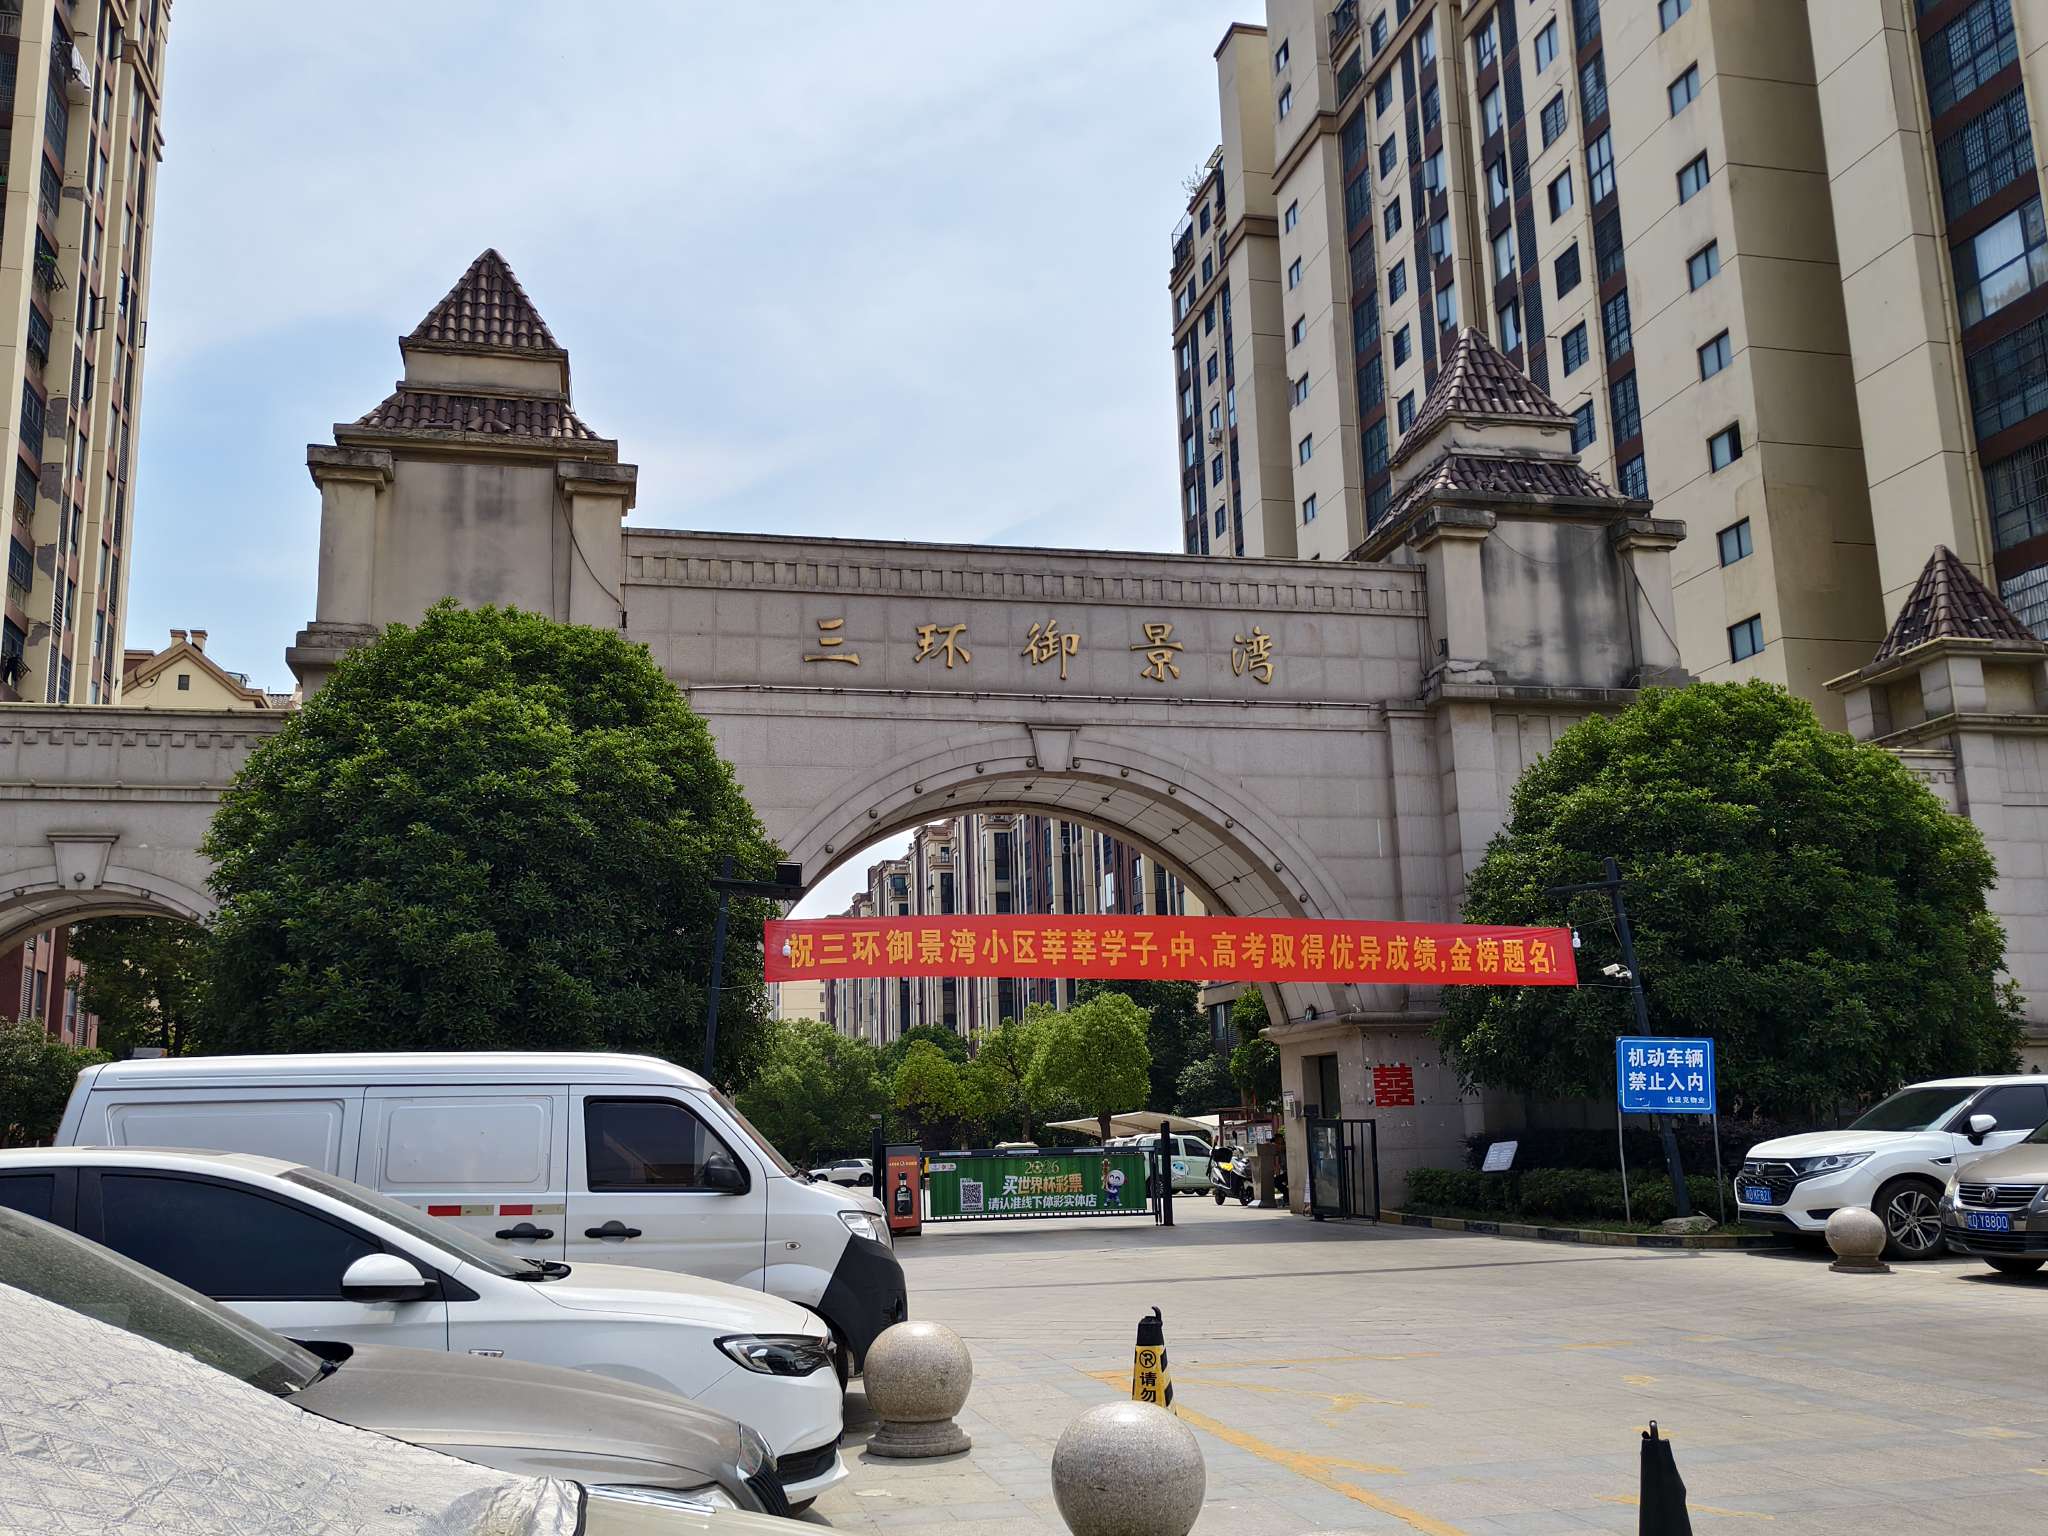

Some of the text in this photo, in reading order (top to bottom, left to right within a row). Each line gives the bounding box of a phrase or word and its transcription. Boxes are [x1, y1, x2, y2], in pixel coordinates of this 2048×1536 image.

[803, 617, 1275, 684] 三环御景湾
[1628, 1047, 1704, 1068] 机动车辆
[1628, 1071, 1704, 1092] 禁止入内
[1002, 1173, 1083, 1196] 买世界杯彩票
[988, 1194, 1097, 1211] 请认准线下体彩实体店
[1139, 1371, 1157, 1403] 请勿
